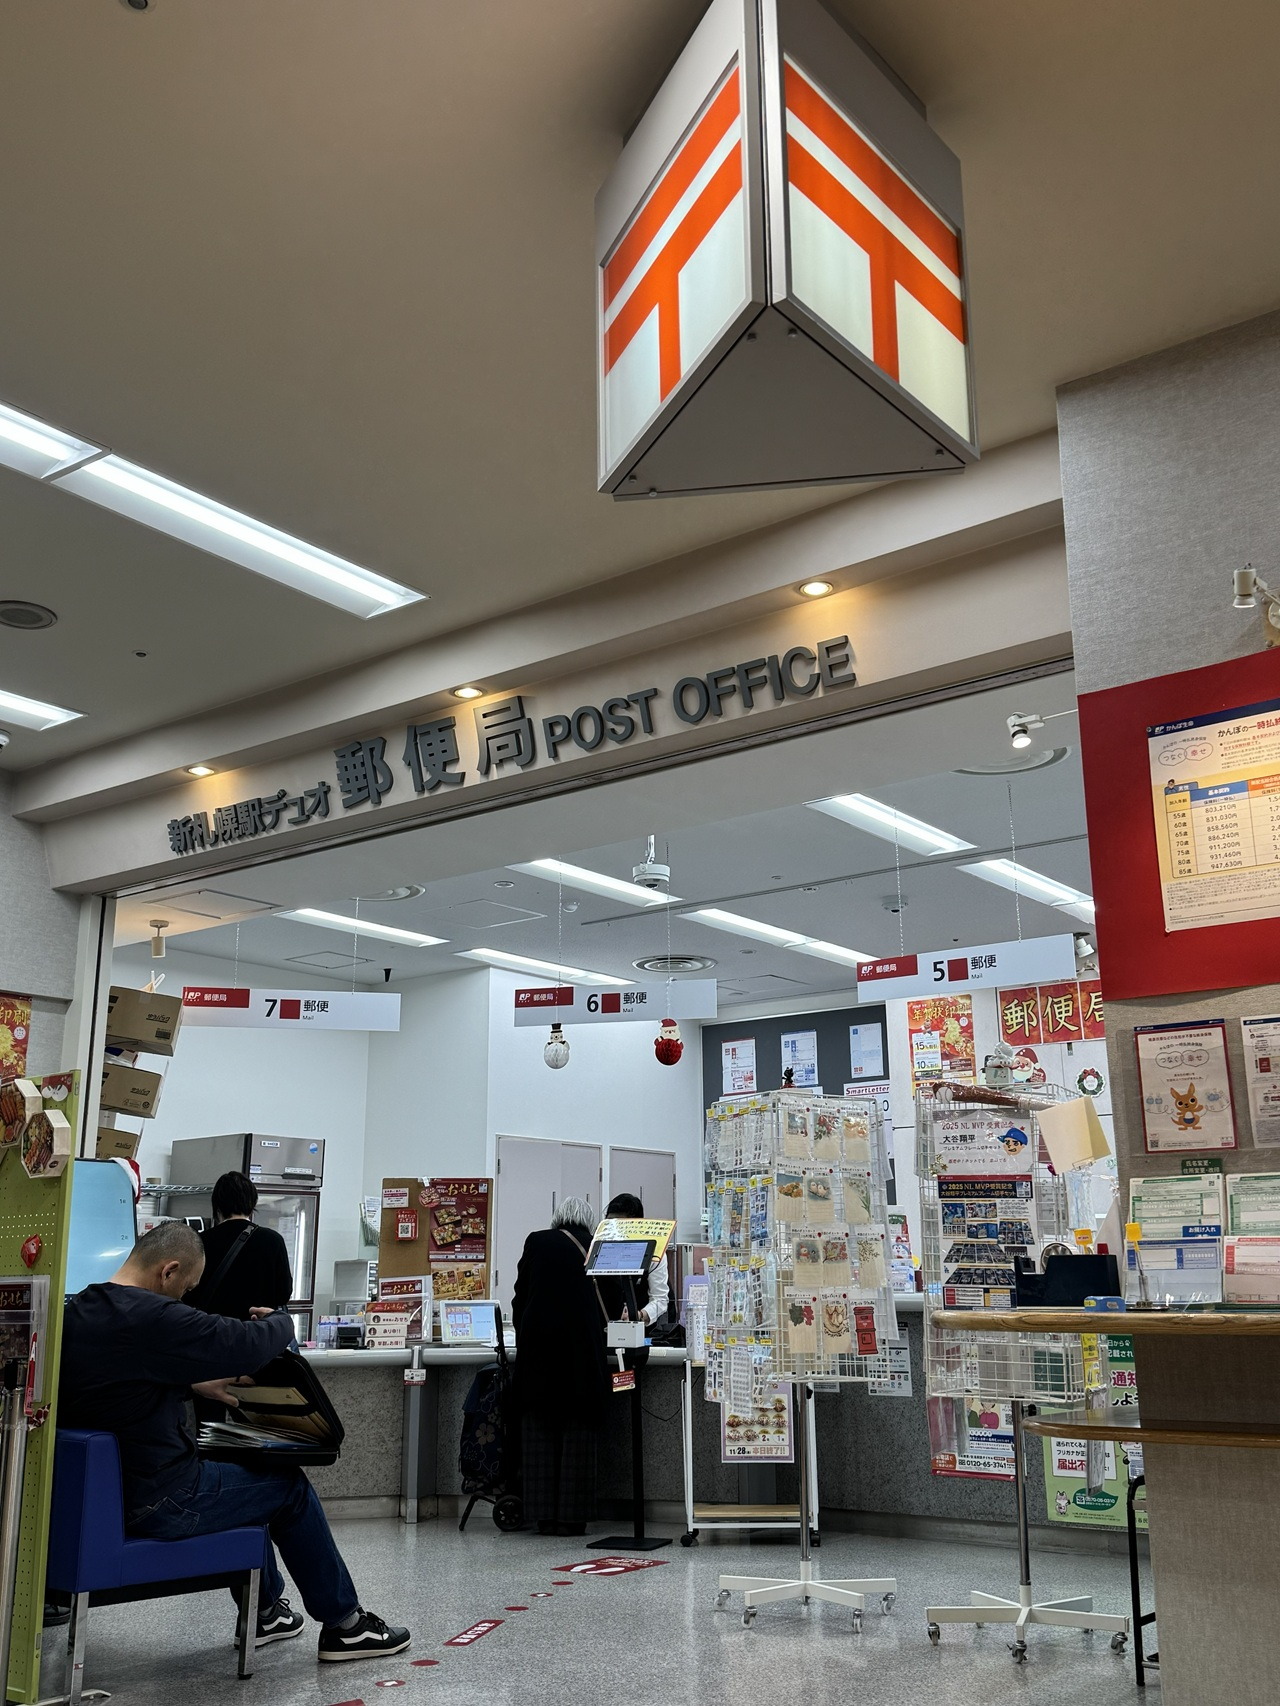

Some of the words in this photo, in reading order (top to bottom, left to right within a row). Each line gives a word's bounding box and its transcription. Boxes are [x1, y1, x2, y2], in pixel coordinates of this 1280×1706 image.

[167, 781, 331, 855] 新札幌駅デュオ
[335, 695, 538, 808] 郵便局
[543, 688, 660, 758] POST
[672, 635, 856, 724] OFFICE
[1191, 748, 1206, 757] 幸せ
[876, 963, 897, 973] 郵便局
[933, 961, 945, 981] 5
[971, 954, 997, 970] 郵便
[204, 993, 227, 1002] 郵便局
[533, 993, 554, 1001] 郵便局
[587, 993, 599, 1013] 6
[623, 992, 647, 1005] 郵便
[265, 999, 278, 1017] 7
[303, 1000, 329, 1013] 郵便
[146, 1013, 171, 1023] ゆうパック
[130, 1087, 151, 1096] ゆうパック
[846, 1086, 890, 1095] SmartLetter
[942, 1121, 959, 1130] 2025
[986, 1120, 1015, 1130] 受賞記念
[943, 1134, 976, 1143] 大谷翔平
[448, 1183, 478, 1196] おせち
[752, 1446, 785, 1455] 本日終了!!
[967, 1460, 1007, 1469] 0120-65-3741
